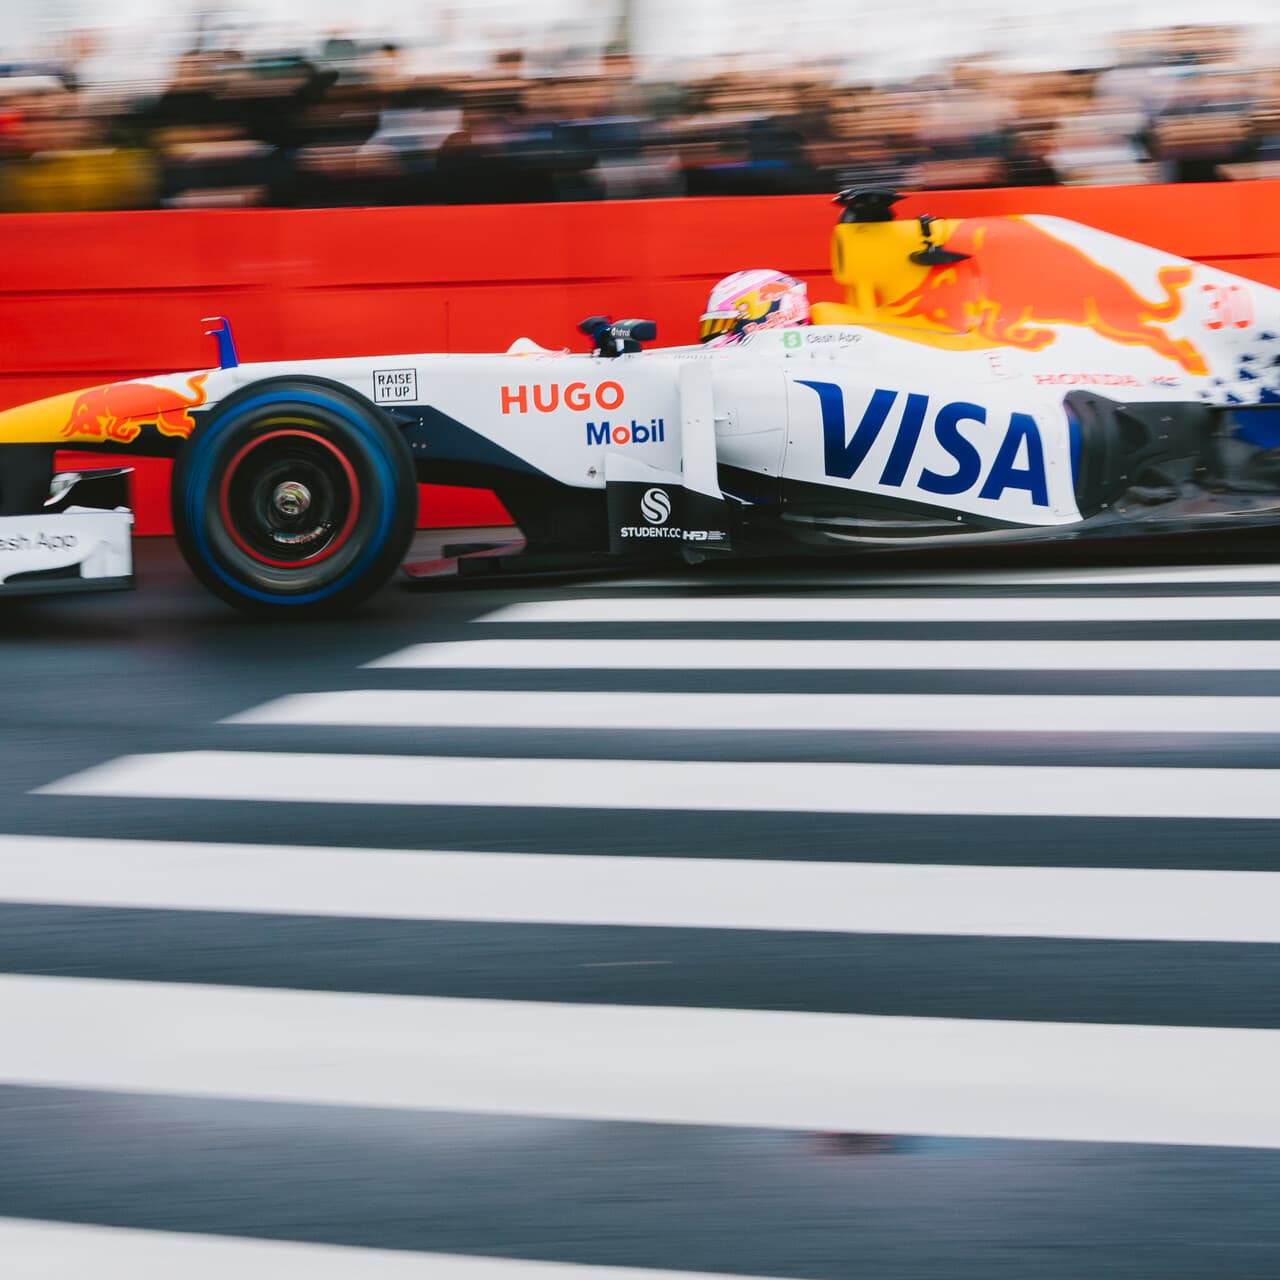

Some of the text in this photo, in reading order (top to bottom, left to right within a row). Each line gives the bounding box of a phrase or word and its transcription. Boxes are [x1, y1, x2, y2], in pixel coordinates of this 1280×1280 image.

[378, 373, 413, 385] RAISE
[1033, 373, 1145, 387] HONDA
[381, 385, 410, 398] IT UP
[501, 380, 625, 415] HUGO
[586, 418, 665, 446] Mobil
[794, 379, 1049, 507] VISA
[34, 531, 79, 552] App
